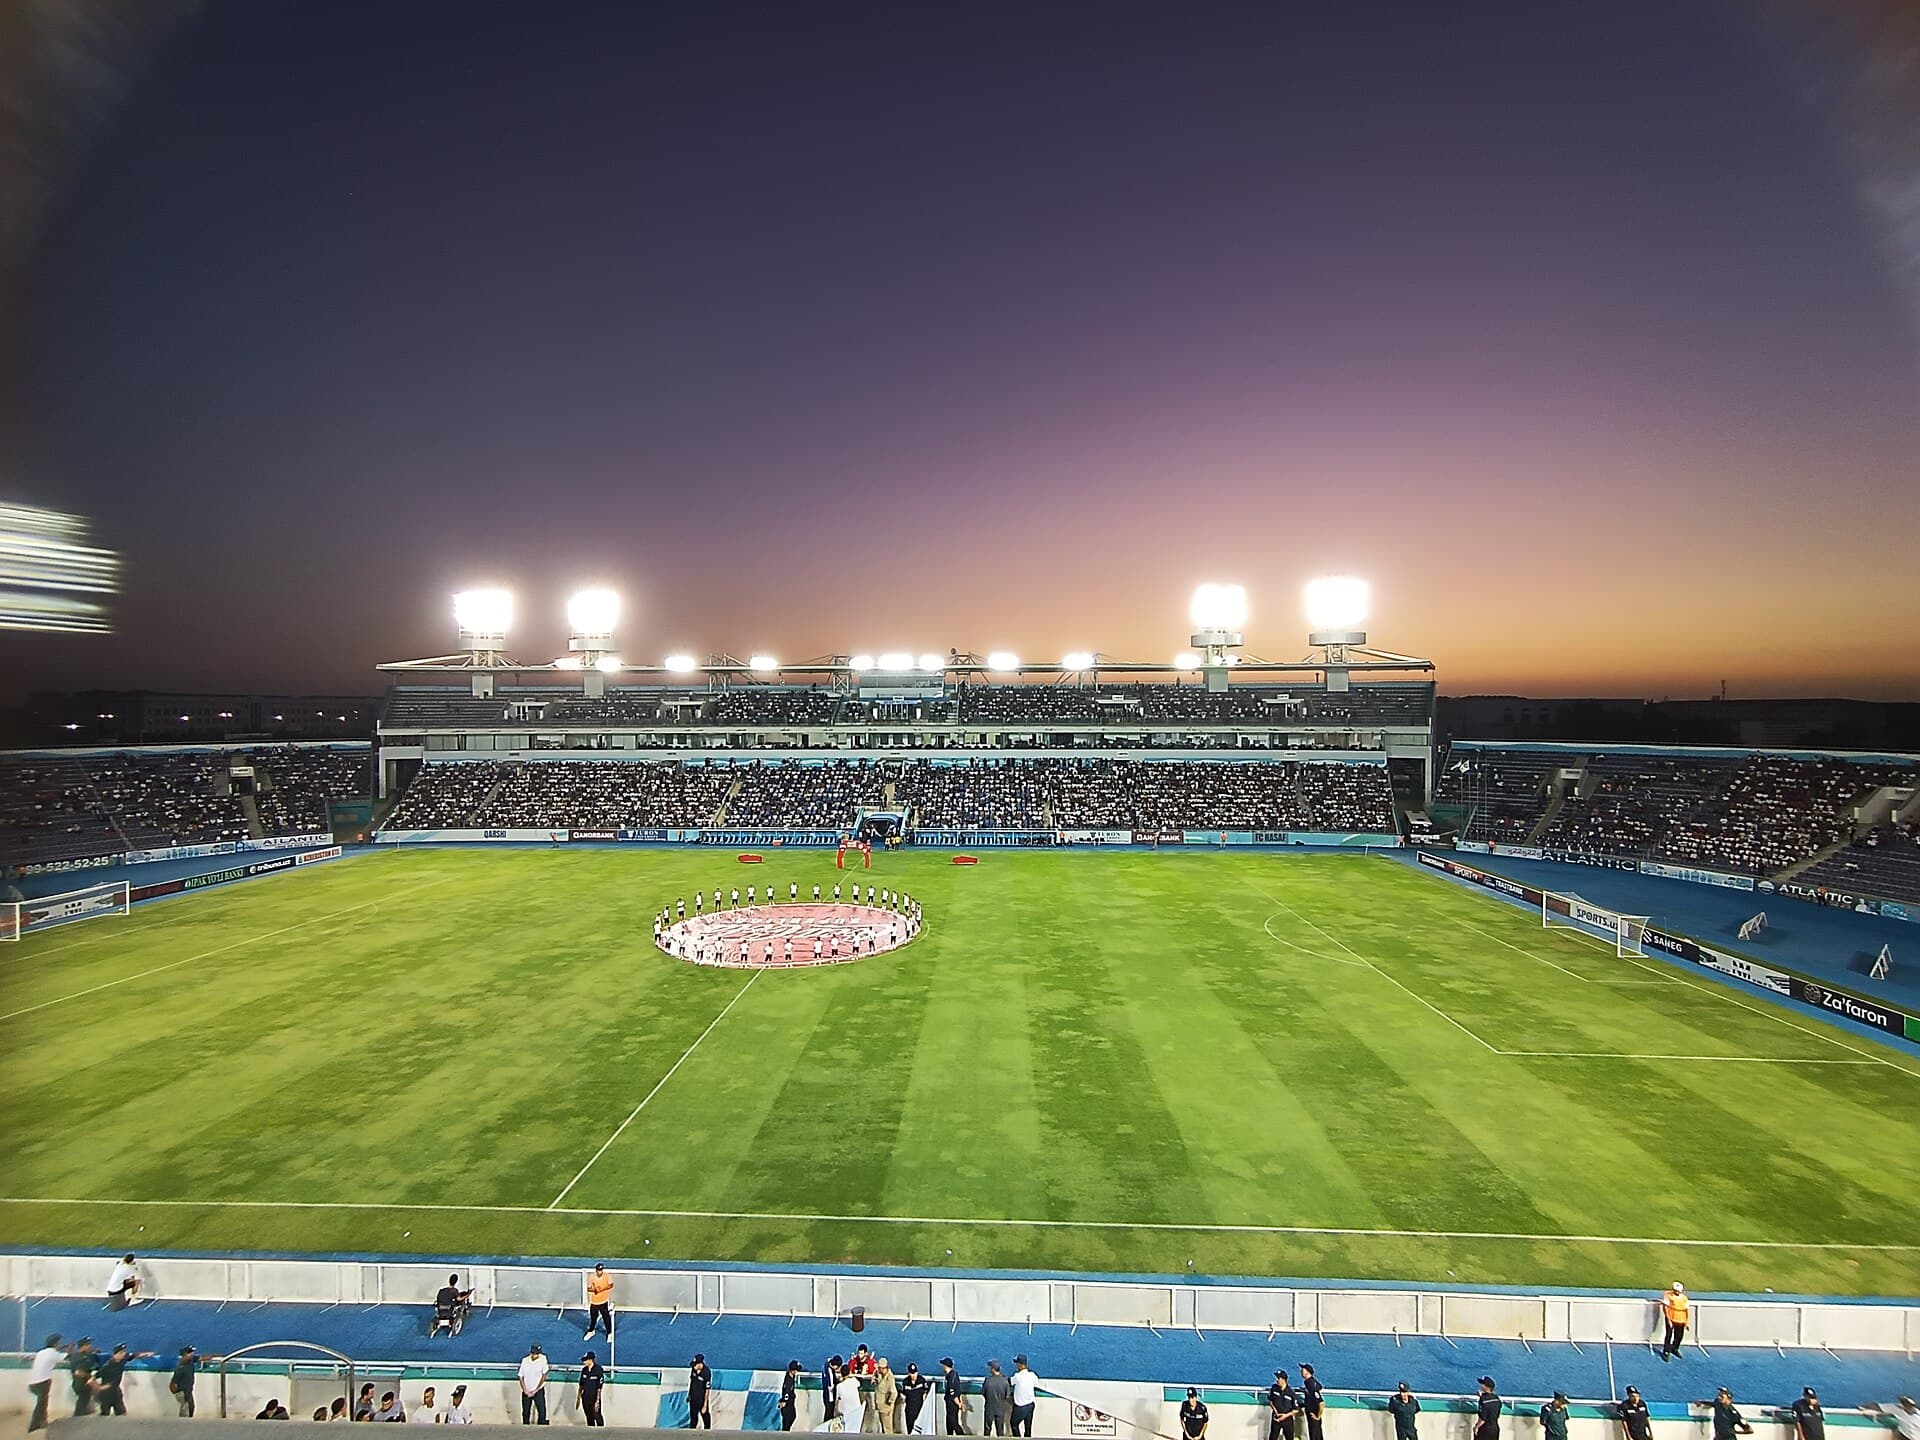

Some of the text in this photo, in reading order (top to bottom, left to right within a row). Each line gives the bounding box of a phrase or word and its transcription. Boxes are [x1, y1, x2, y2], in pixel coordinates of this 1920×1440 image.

[263, 834, 328, 846] ATLANTIC
[1256, 832, 1264, 841] FC
[25, 856, 109, 875] 99-522-52-25
[1542, 851, 1635, 871] ATLANTIC
[191, 876, 207, 887] IPAK
[1653, 935, 1682, 952] SANEG
[1822, 991, 1888, 1027] Za'faron
